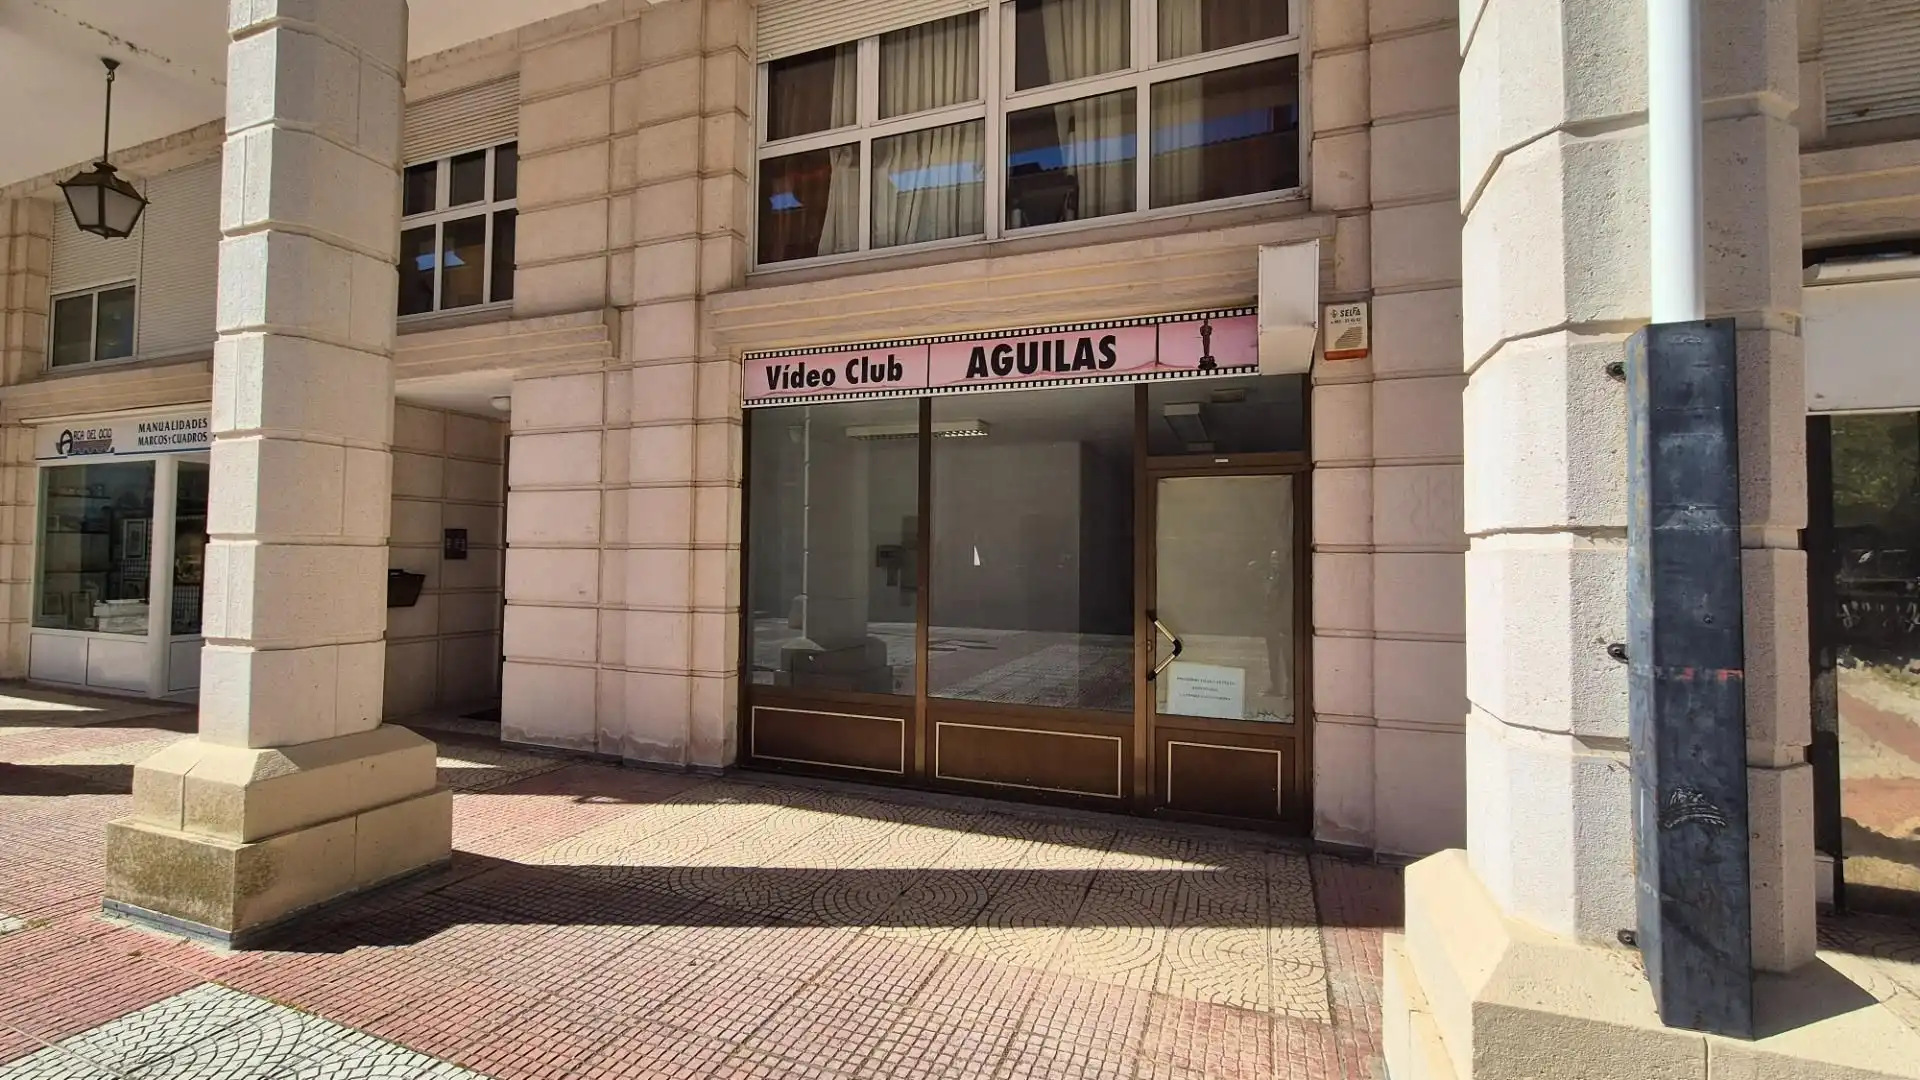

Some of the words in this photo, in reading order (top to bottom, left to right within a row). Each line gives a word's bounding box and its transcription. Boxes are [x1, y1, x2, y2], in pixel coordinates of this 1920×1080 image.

[966, 335, 1117, 380] AGUILAS
[766, 359, 836, 391] Vídeo
[846, 355, 903, 385] Club
[138, 418, 208, 433] MANUALIDADES
[138, 434, 168, 446] MARCOS
[172, 432, 208, 444] CUADROS
